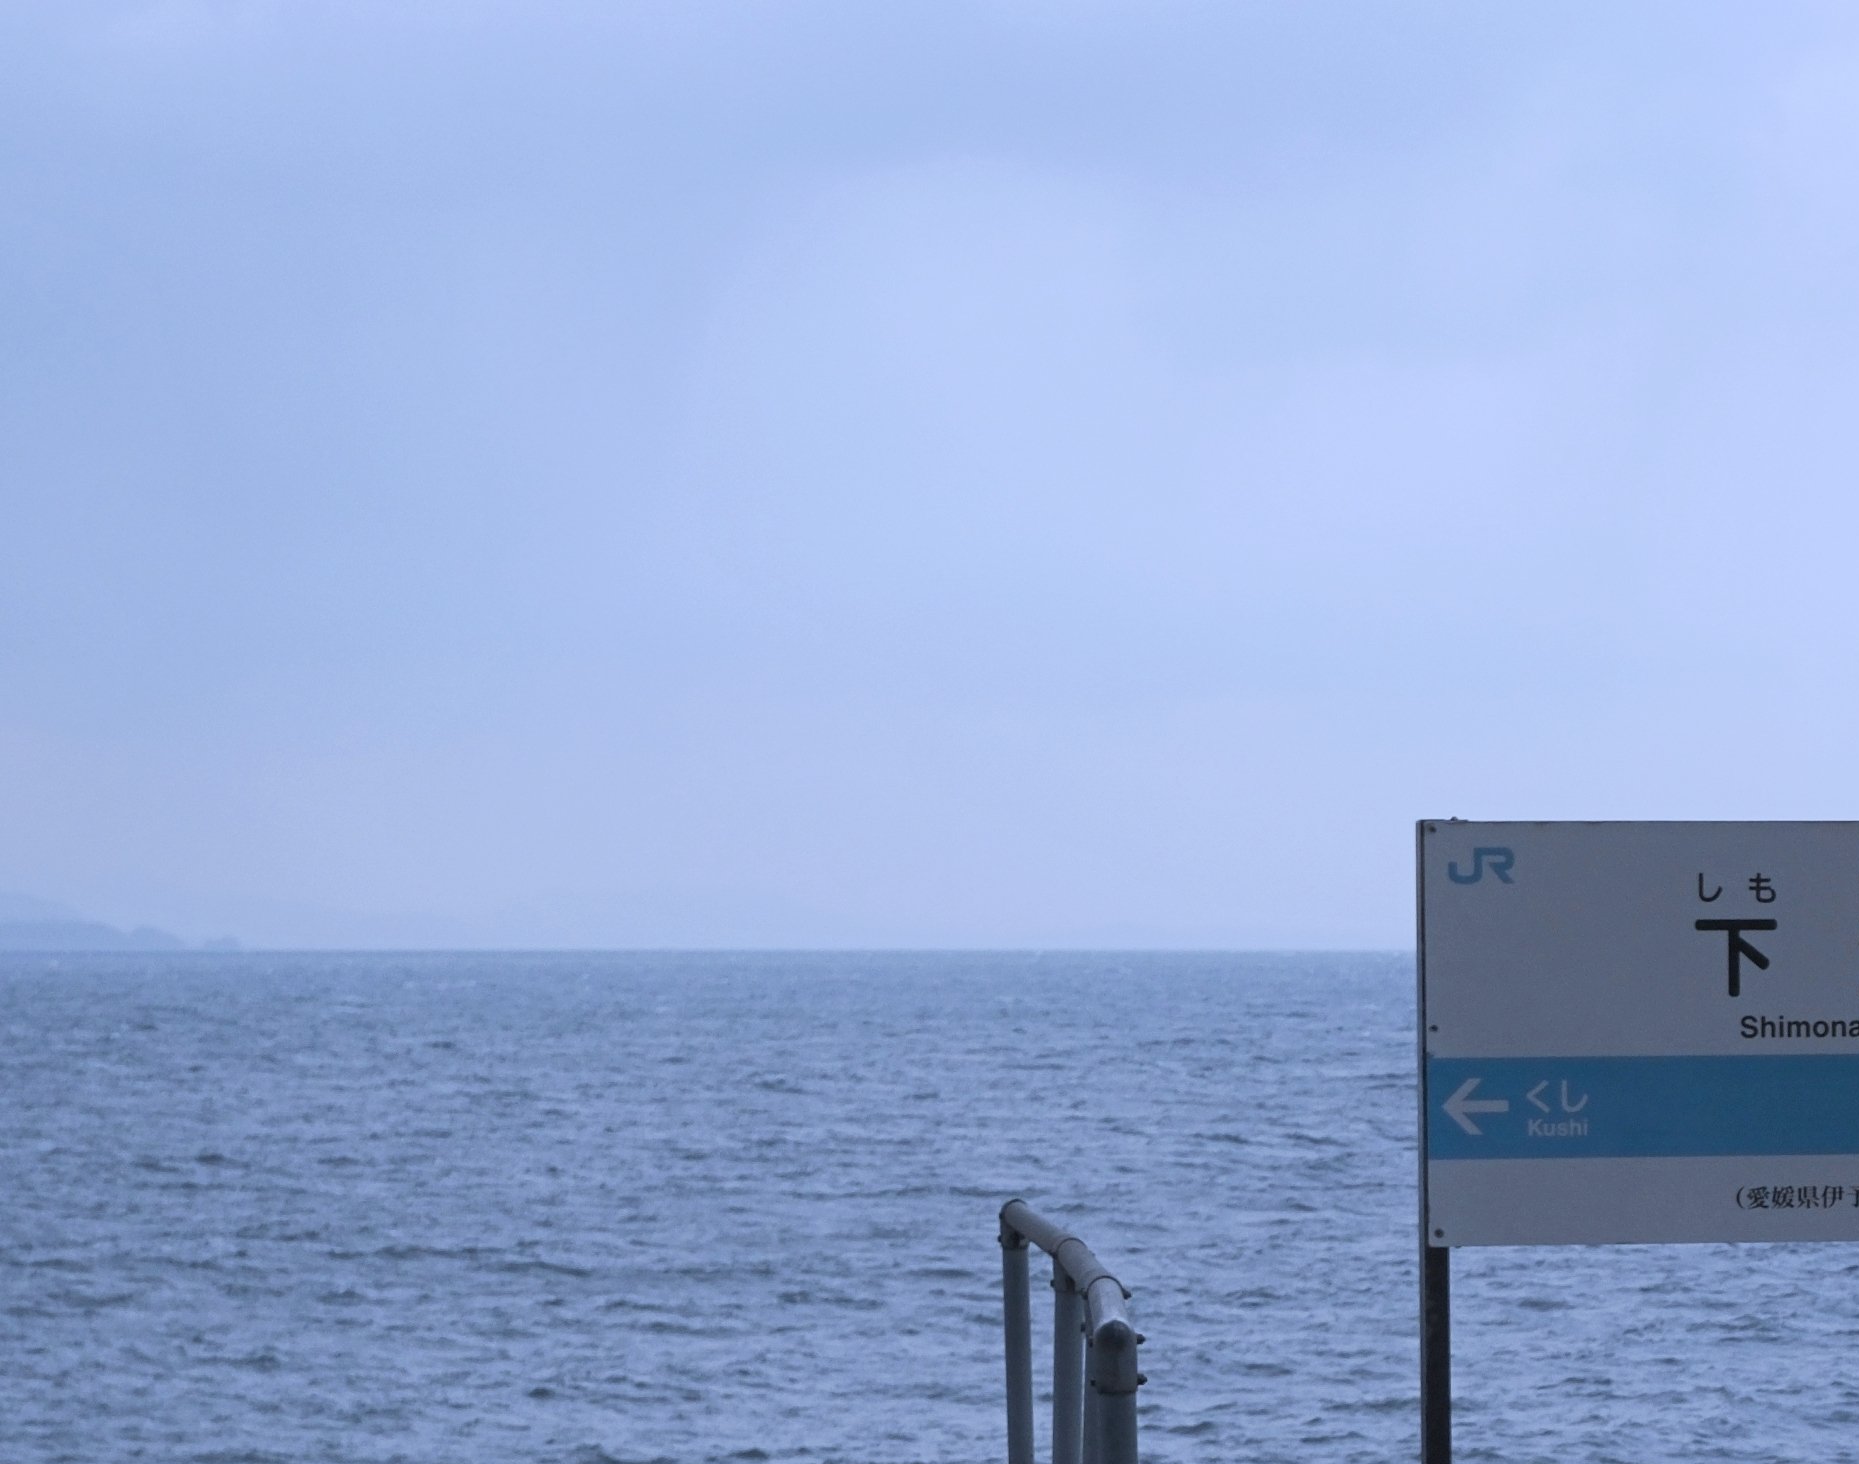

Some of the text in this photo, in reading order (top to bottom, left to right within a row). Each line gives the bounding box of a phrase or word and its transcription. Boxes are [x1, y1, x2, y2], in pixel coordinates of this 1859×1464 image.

[1448, 847, 1515, 885] JR
[1526, 1080, 1588, 1115] くし
[1528, 1118, 1589, 1138] Kushi
